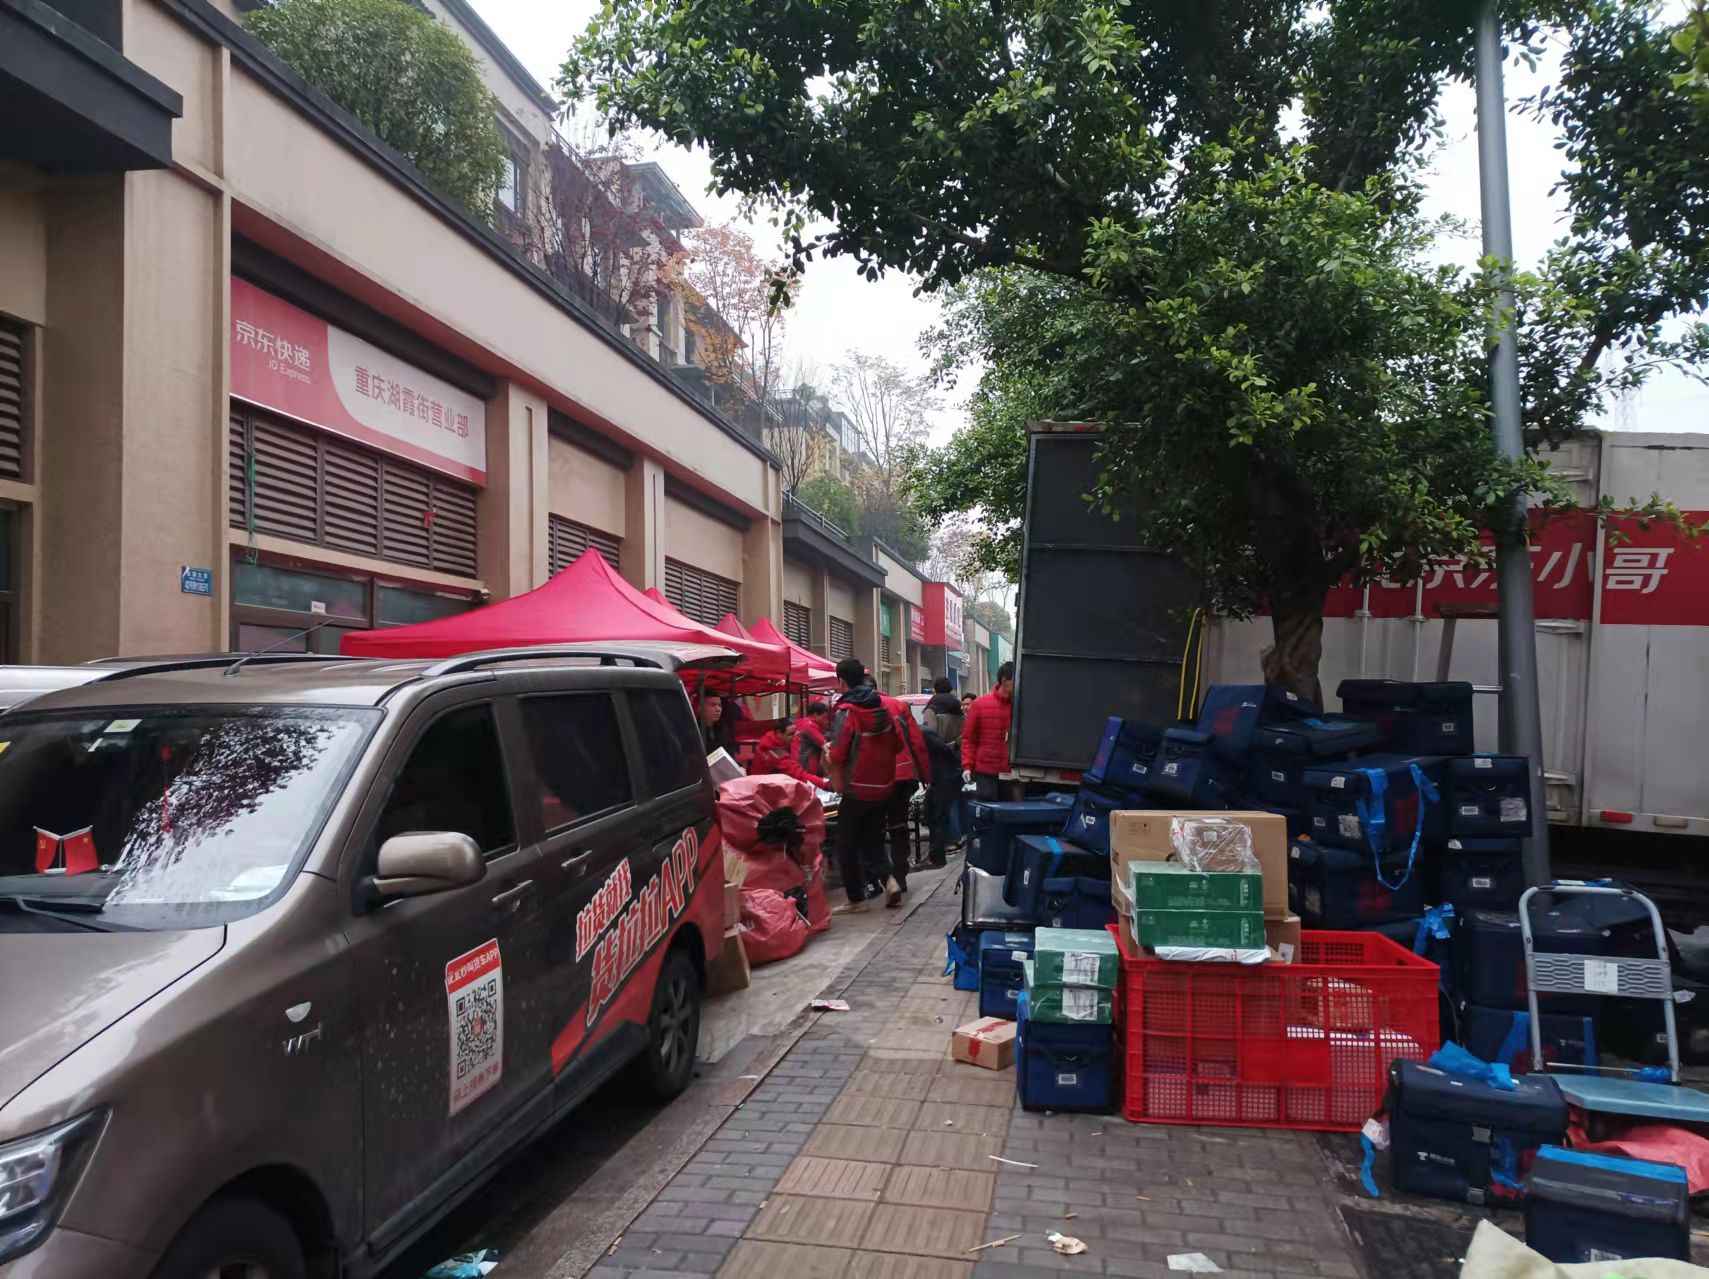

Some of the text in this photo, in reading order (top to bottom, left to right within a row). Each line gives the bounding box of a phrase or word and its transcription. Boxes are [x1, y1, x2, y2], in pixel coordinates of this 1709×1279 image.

[235, 319, 311, 371] 京东快递
[355, 365, 470, 439] 重庆湖霞街营业部
[586, 826, 699, 1028] 货拉拉APP
